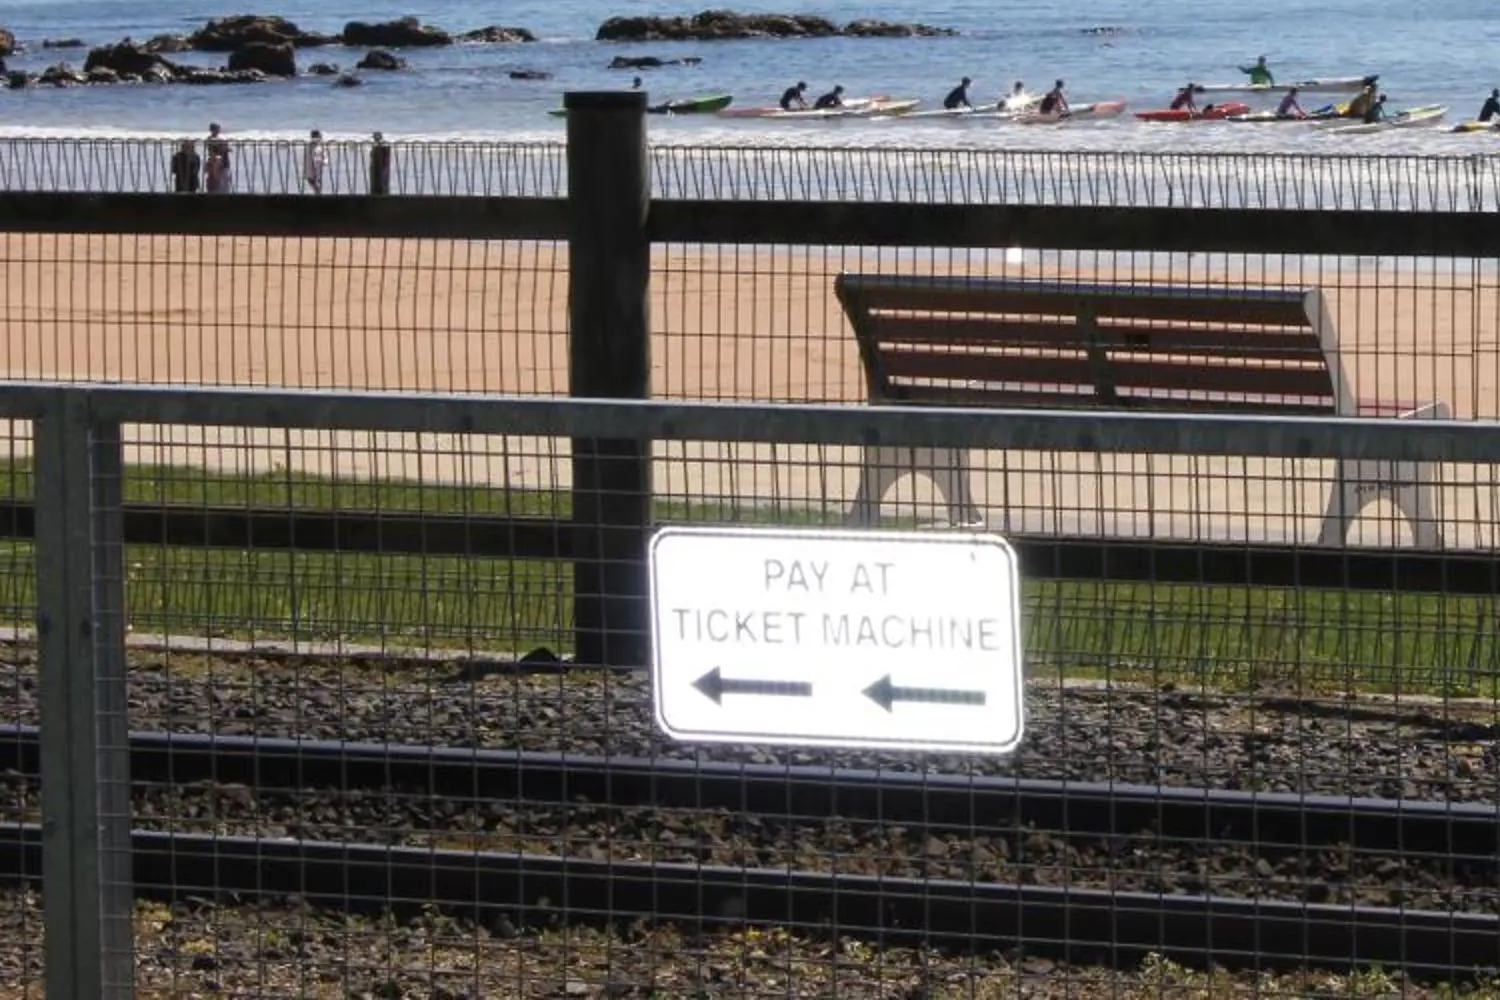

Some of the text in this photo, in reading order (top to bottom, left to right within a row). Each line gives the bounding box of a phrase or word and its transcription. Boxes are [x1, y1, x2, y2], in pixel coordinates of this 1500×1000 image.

[764, 559, 895, 596] PAY AT
[672, 608, 1000, 651] TICKET MACHINE
